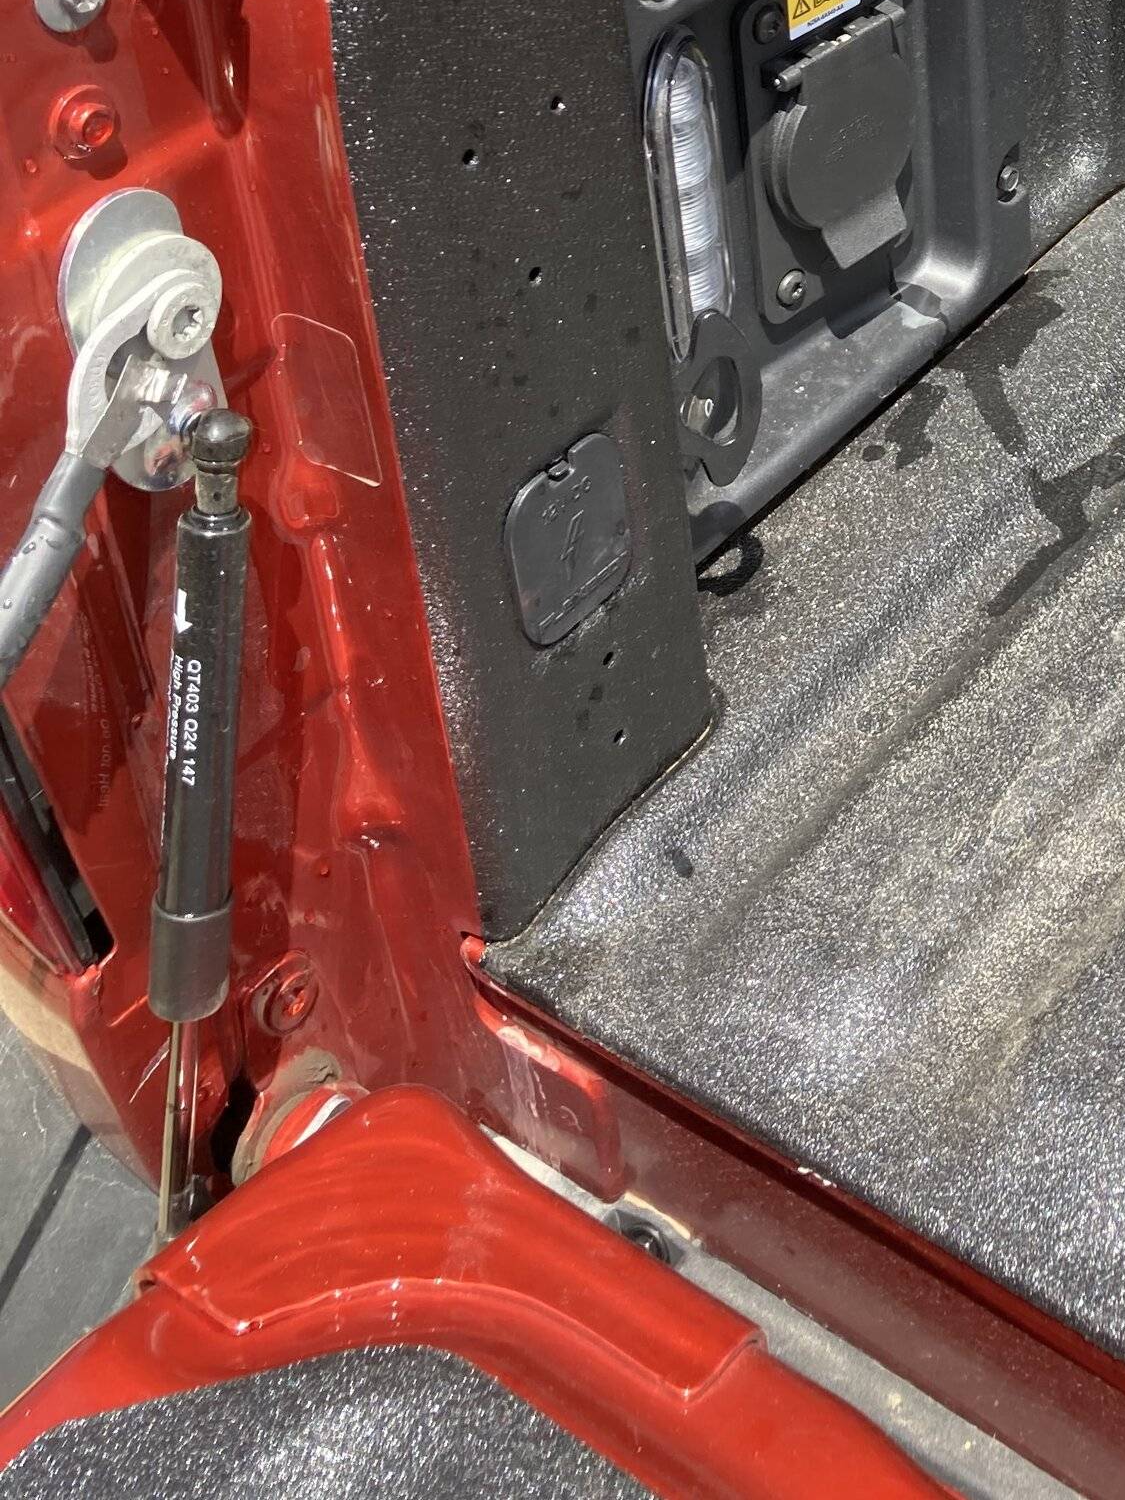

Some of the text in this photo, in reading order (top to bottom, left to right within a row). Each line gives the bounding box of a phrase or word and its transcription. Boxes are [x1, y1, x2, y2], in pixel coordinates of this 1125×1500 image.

[169, 654, 184, 761] High Pressure
[181, 659, 202, 787] QT403 Q24 147
